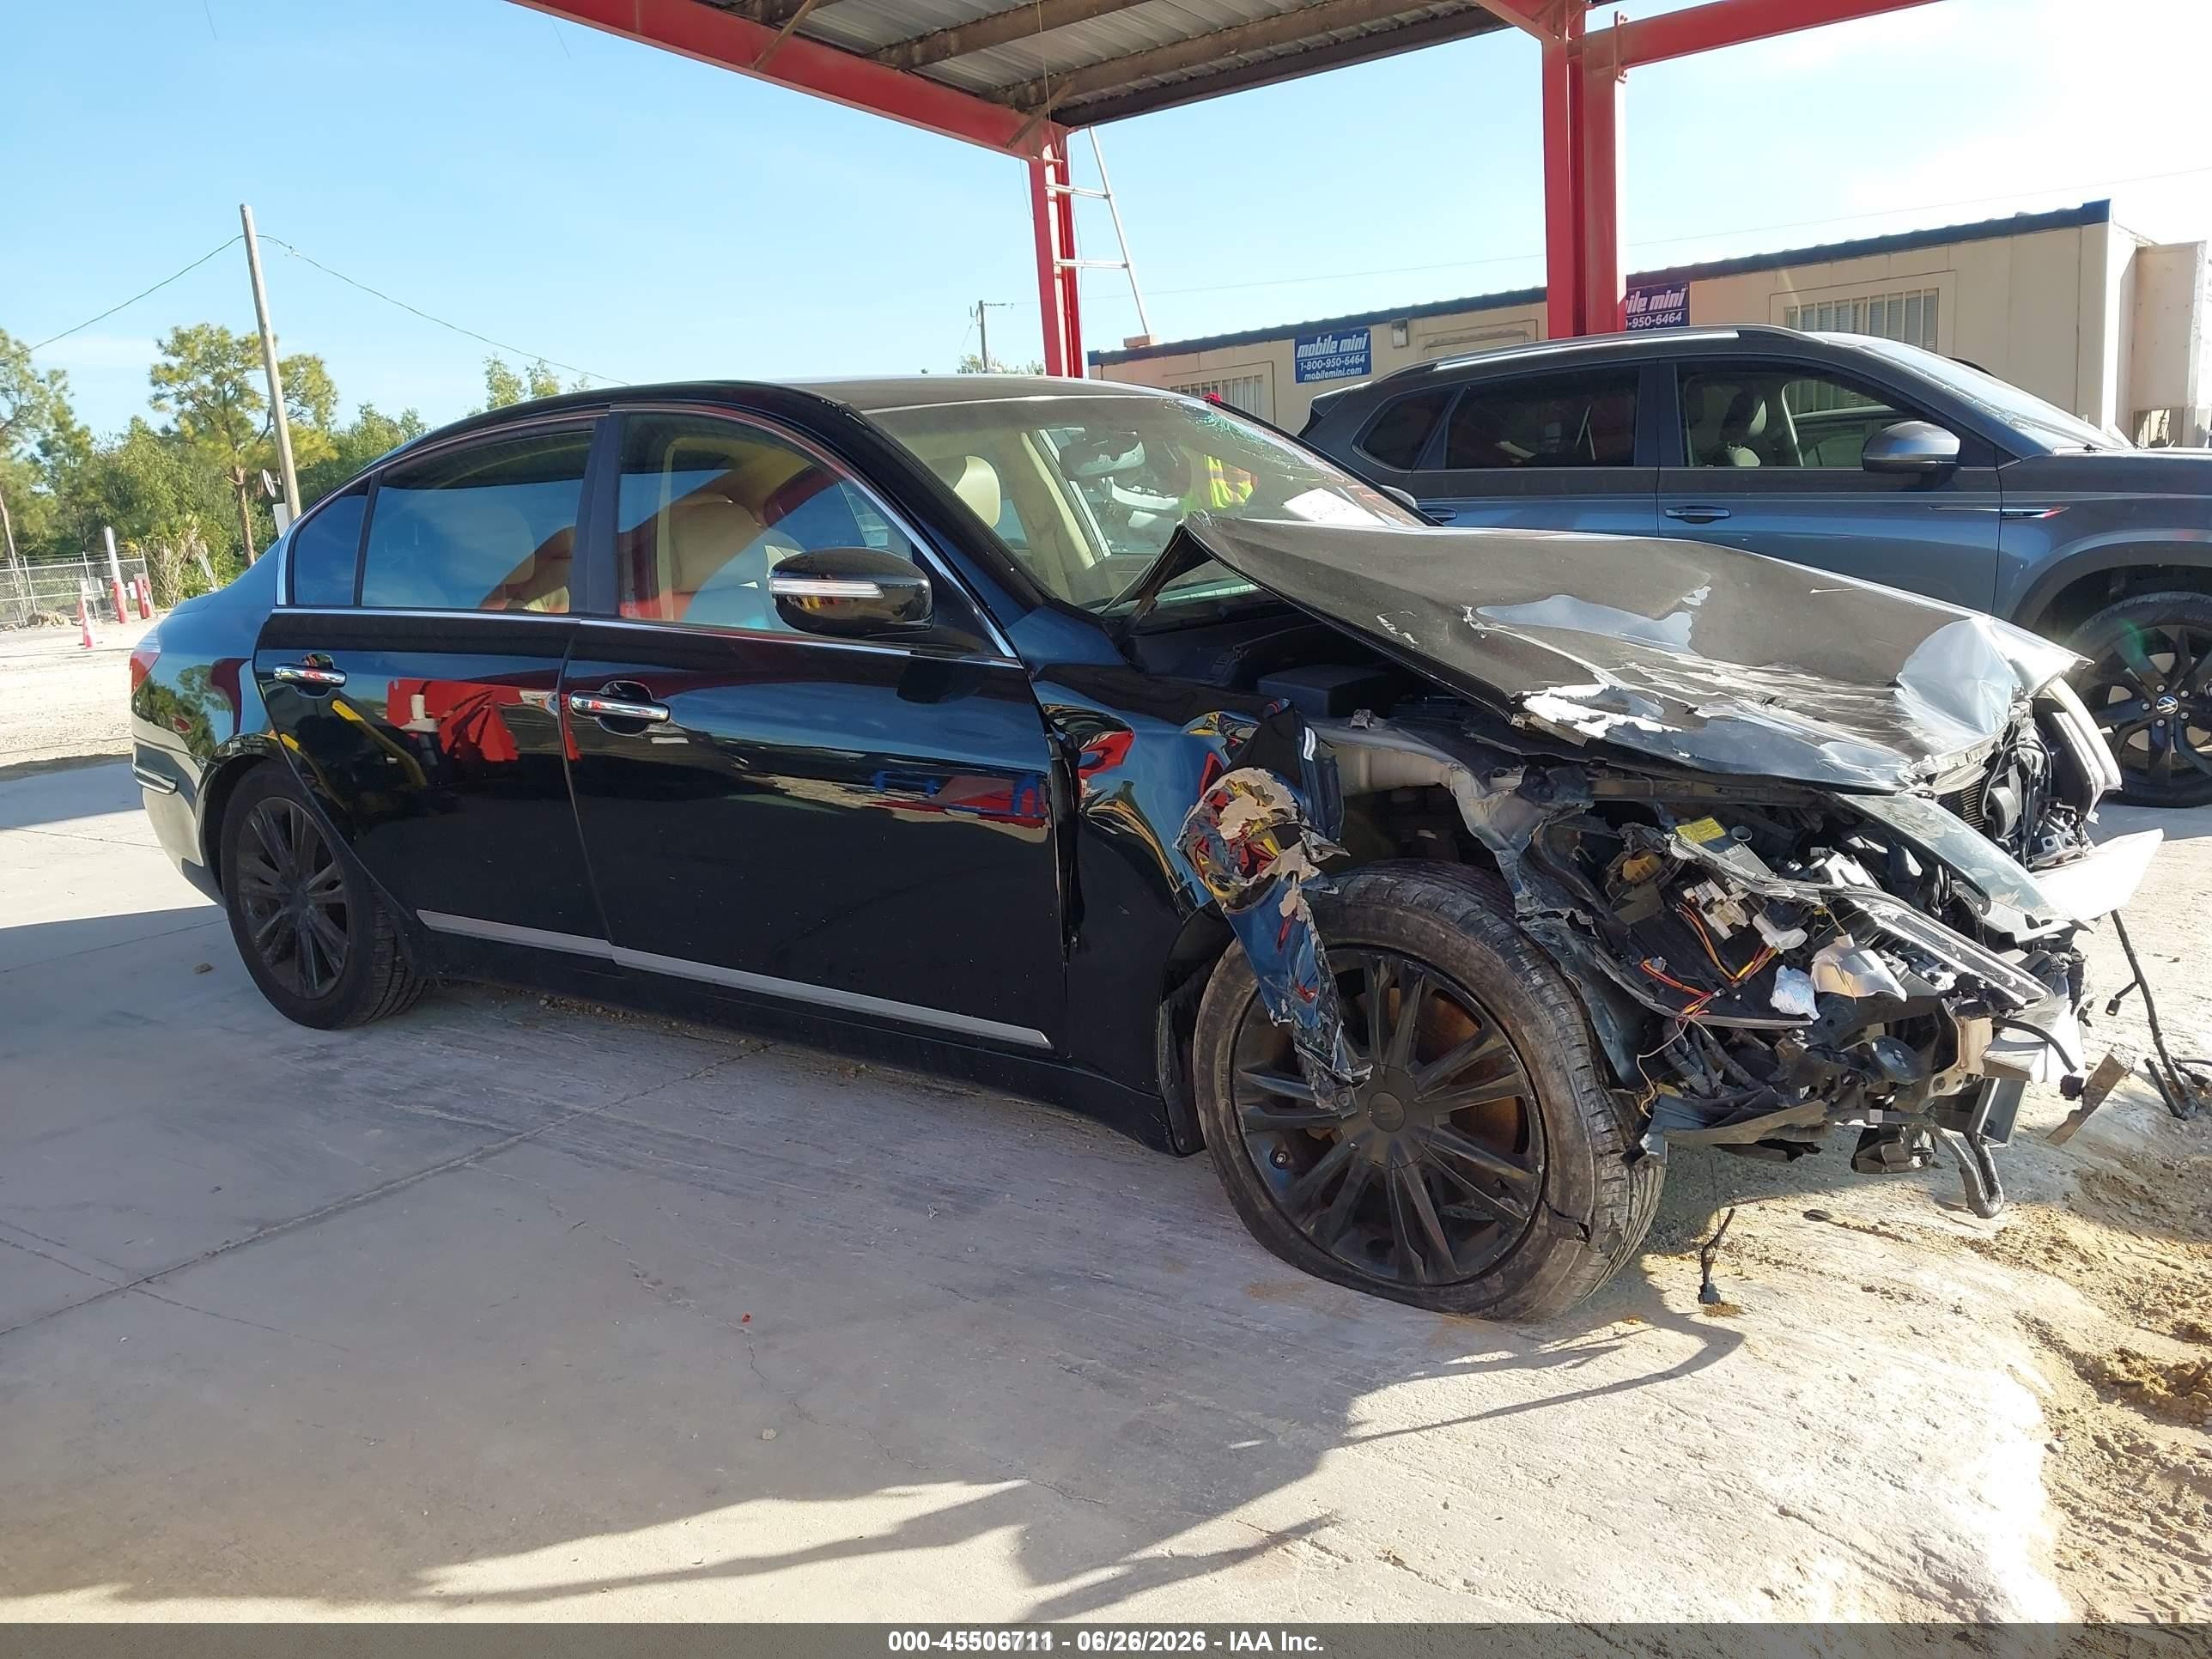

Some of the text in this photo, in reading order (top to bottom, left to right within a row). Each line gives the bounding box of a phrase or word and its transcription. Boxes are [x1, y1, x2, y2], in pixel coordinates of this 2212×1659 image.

[1649, 288, 1686, 310] mini
[1297, 332, 1369, 358] mobile mini
[1300, 354, 1365, 372] 1-800-950-6464
[1304, 367, 1363, 381] mobilemini.com
